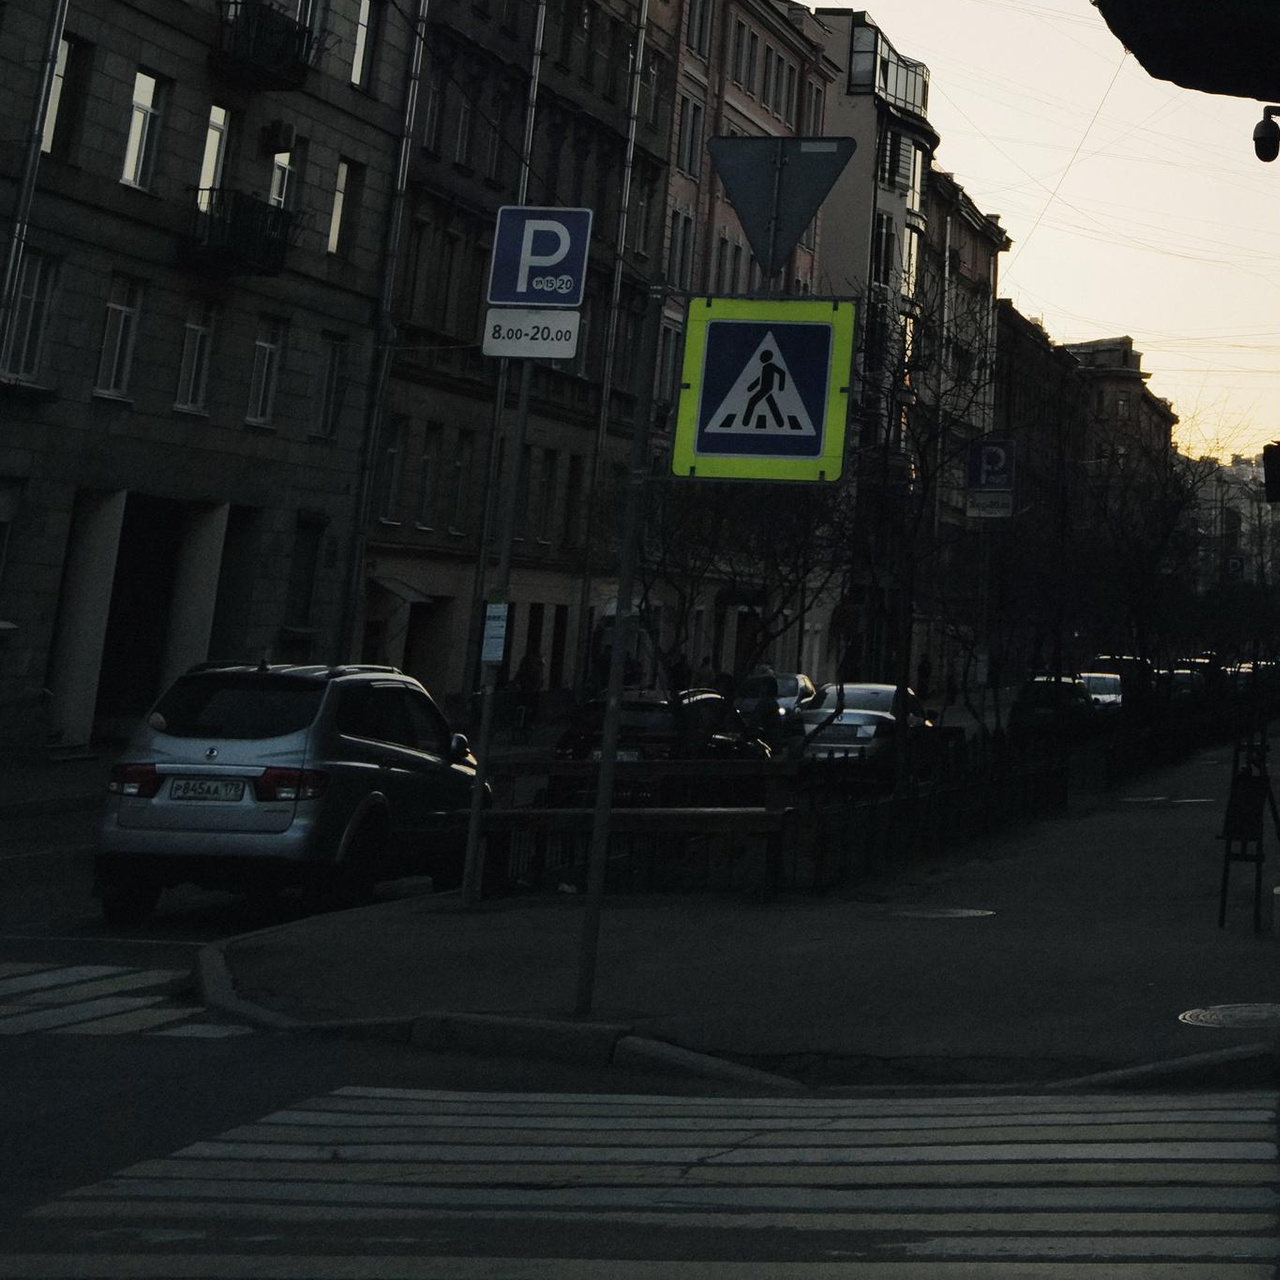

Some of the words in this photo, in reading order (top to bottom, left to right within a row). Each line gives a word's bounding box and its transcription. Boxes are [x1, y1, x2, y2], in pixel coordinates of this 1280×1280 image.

[516, 219, 571, 293] P
[557, 278, 572, 290] 20
[492, 324, 572, 342] 8.00-20.00
